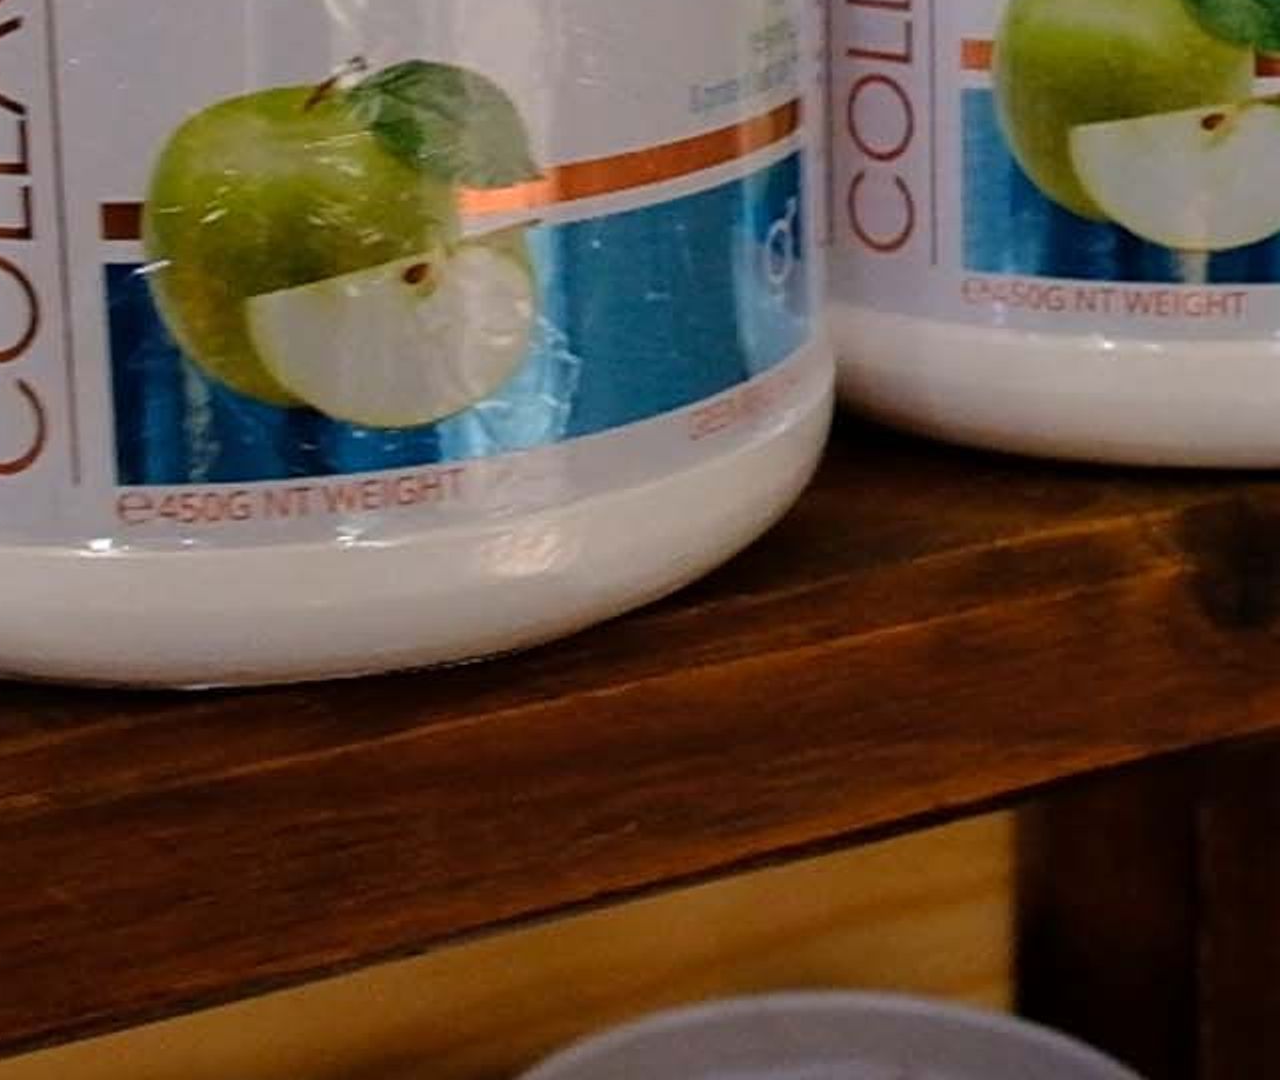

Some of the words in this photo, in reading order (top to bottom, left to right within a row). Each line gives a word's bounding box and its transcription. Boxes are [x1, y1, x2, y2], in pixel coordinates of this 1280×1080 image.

[1074, 288, 1117, 313] NT
[1122, 289, 1250, 317] WEIGHT
[265, 486, 313, 517] NT
[322, 467, 465, 513] WEIGHT
